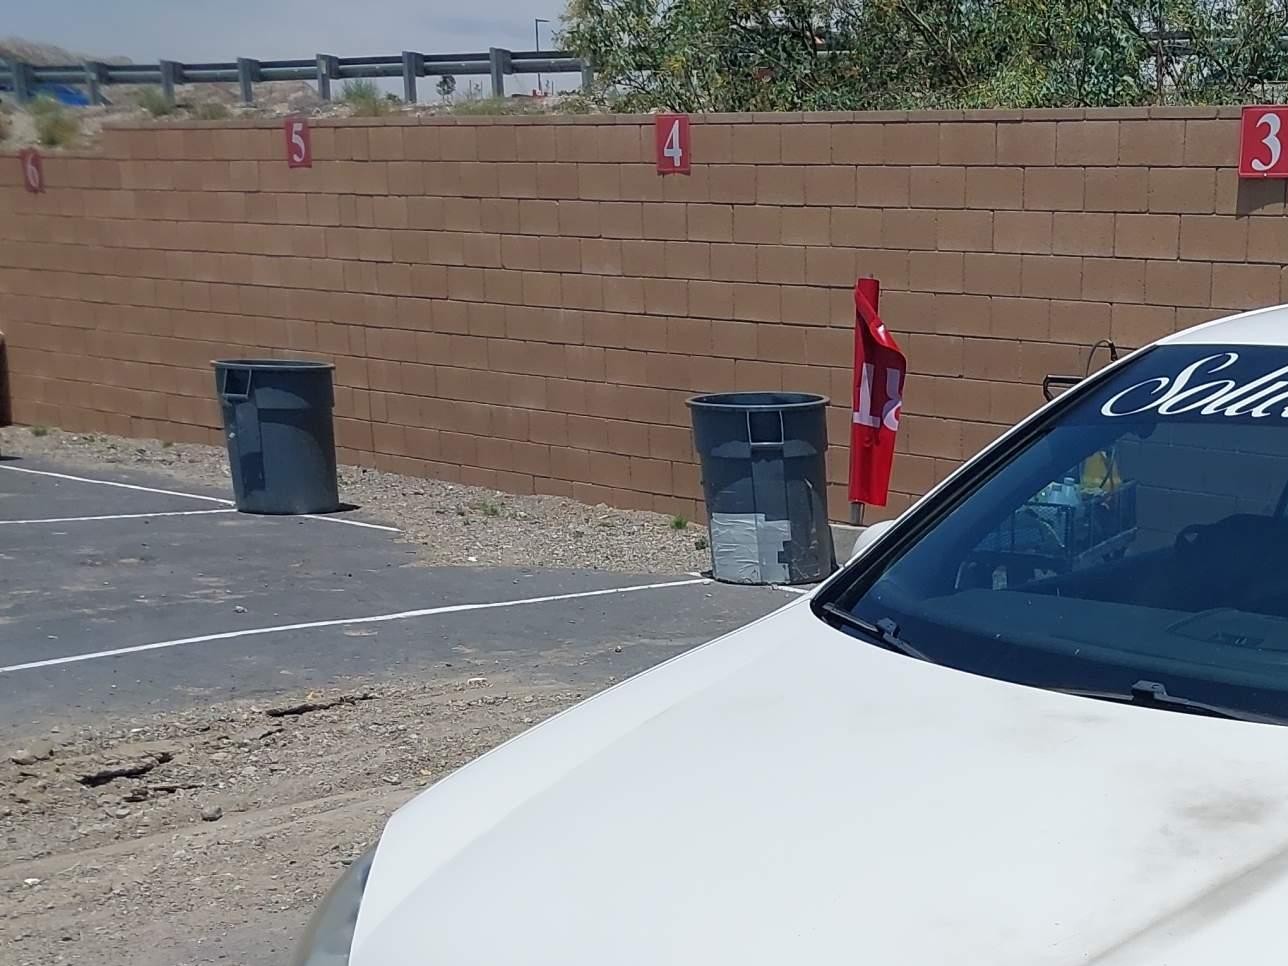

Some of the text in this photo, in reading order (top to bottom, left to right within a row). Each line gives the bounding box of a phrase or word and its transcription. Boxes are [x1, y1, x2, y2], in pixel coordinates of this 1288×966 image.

[291, 123, 305, 162] 5
[664, 120, 682, 167] 4
[1252, 113, 1281, 171] 3
[27, 153, 40, 188] 6
